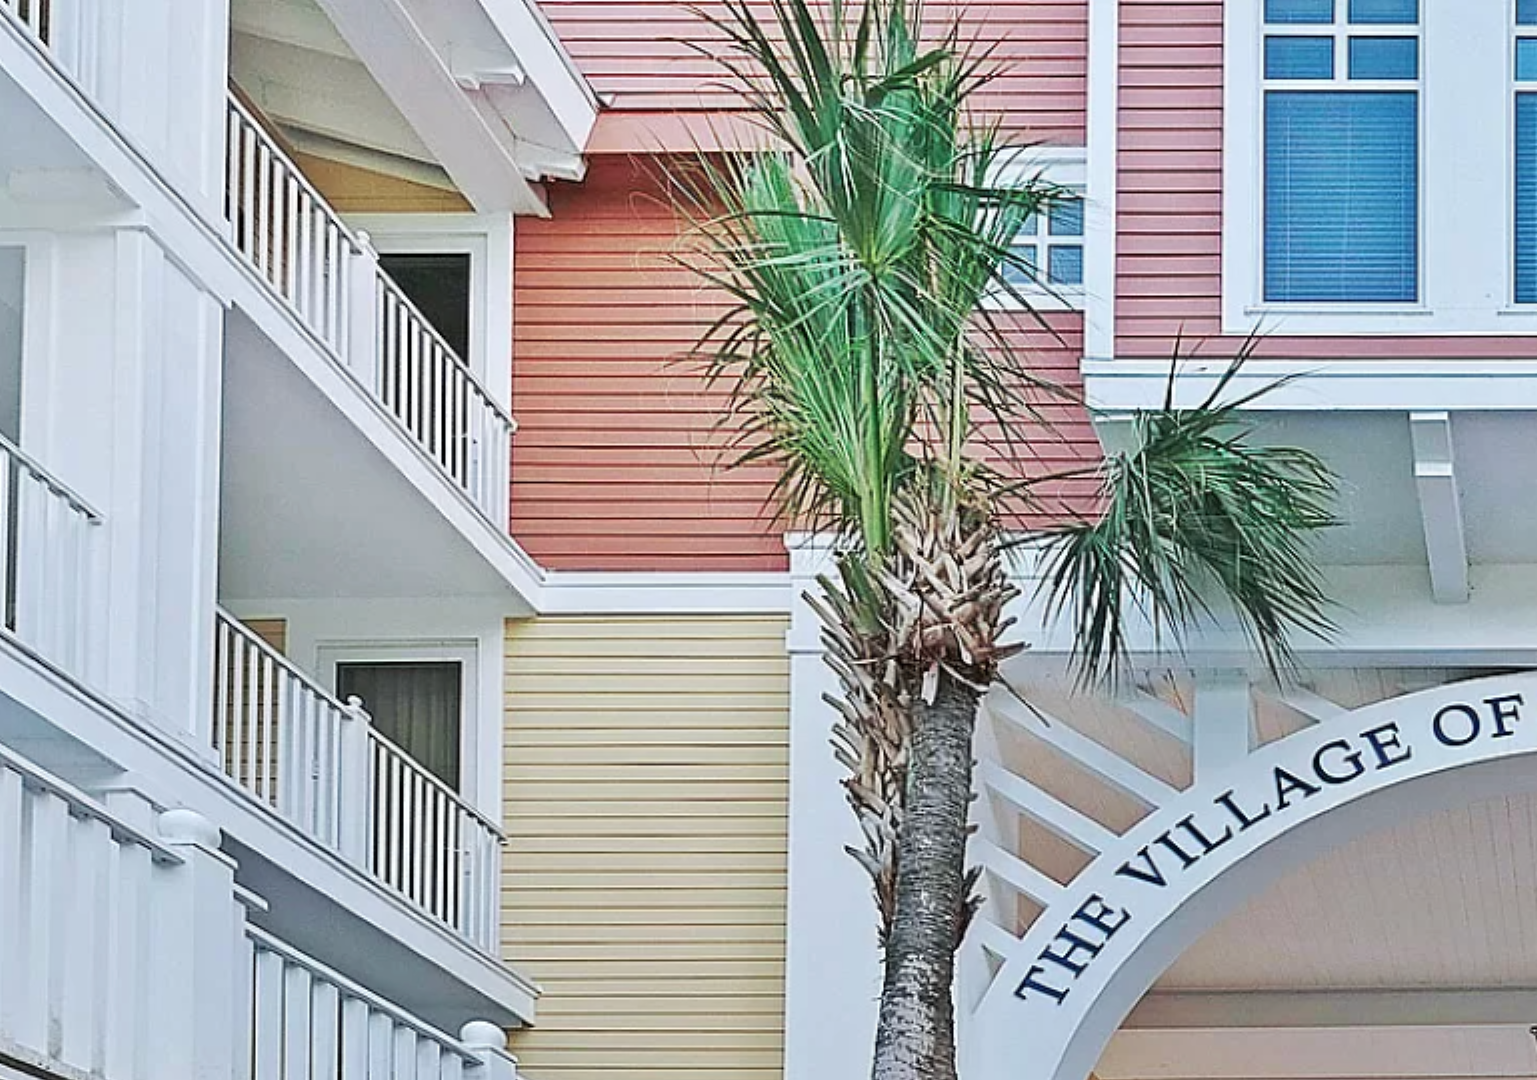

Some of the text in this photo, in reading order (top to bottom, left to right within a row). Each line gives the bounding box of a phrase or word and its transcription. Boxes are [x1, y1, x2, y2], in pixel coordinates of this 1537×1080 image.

[1014, 894, 1131, 1006] THE
[1115, 722, 1412, 887] VILLAGE
[1432, 692, 1525, 747] OF
